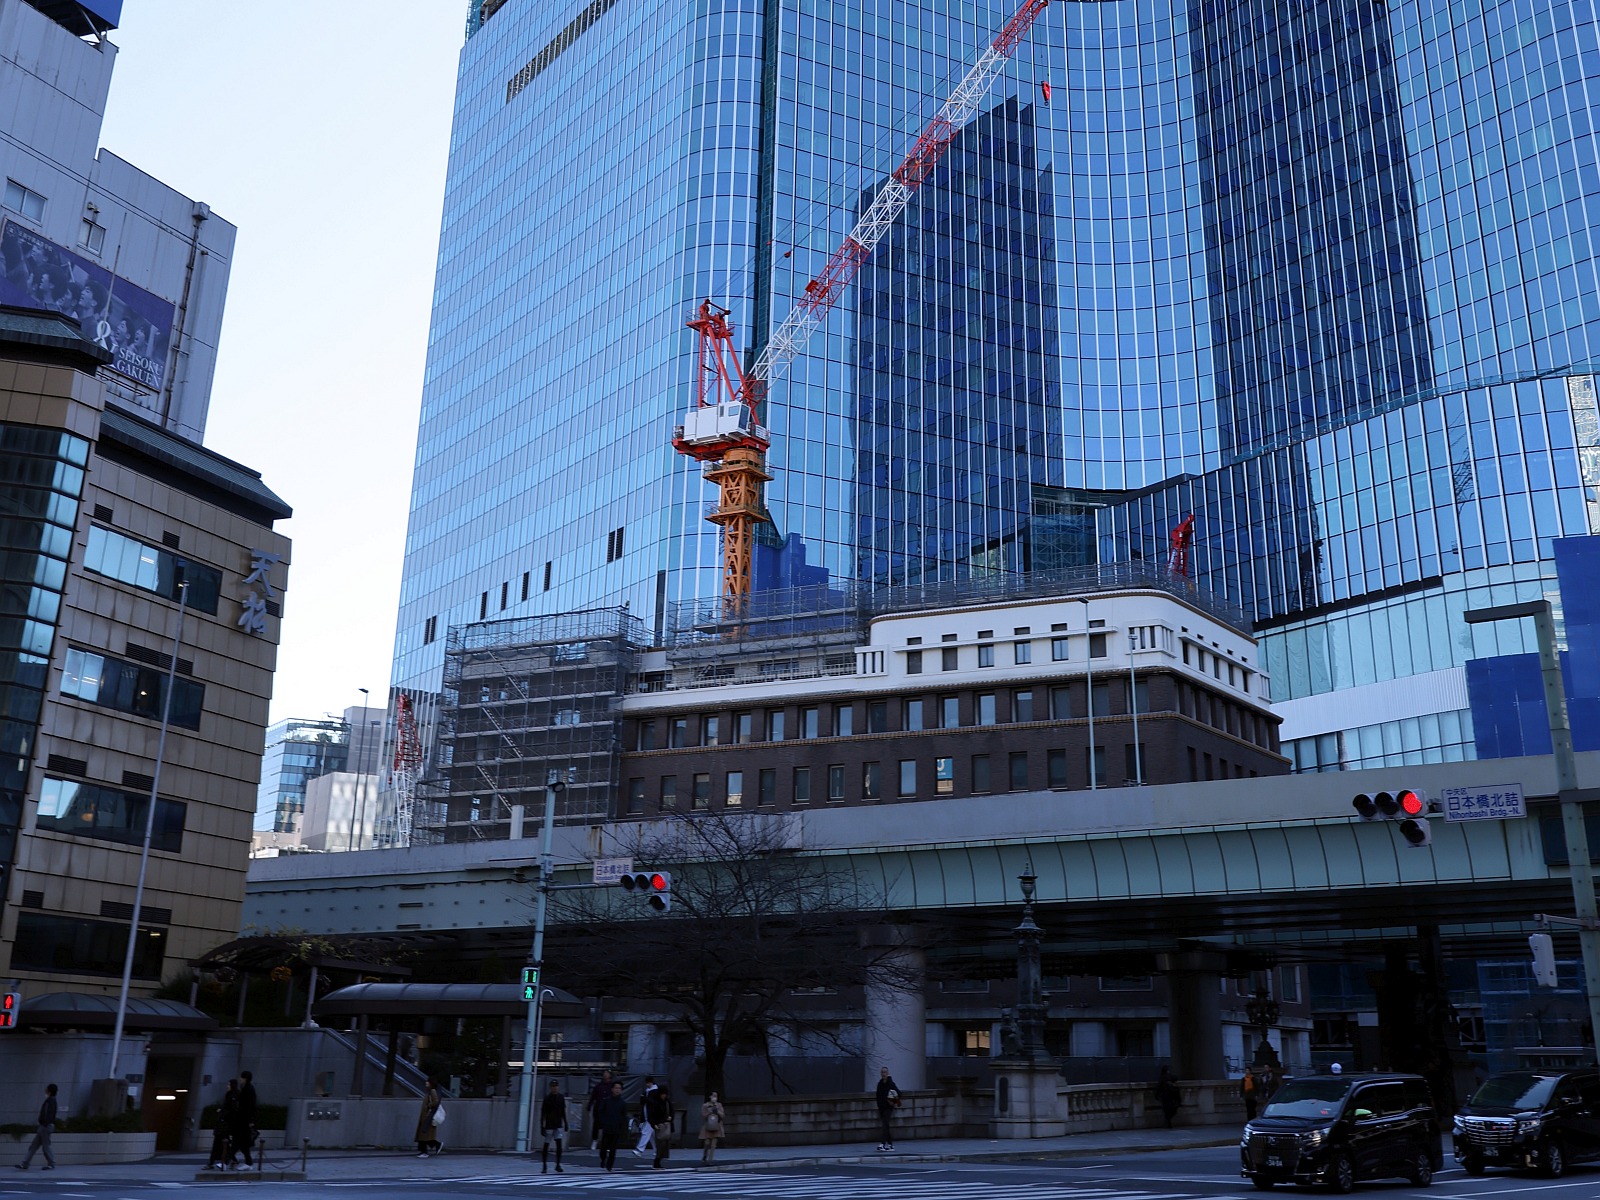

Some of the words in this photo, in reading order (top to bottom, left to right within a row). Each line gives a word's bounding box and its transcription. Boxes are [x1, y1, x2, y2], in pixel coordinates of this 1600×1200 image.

[118, 347, 163, 376] SEISOKU
[116, 359, 161, 387] GAKUEN
[1446, 787, 1468, 796] 中央区
[1448, 791, 1519, 811] 日本橋北詰
[1449, 808, 1489, 819] Nihonbashi
